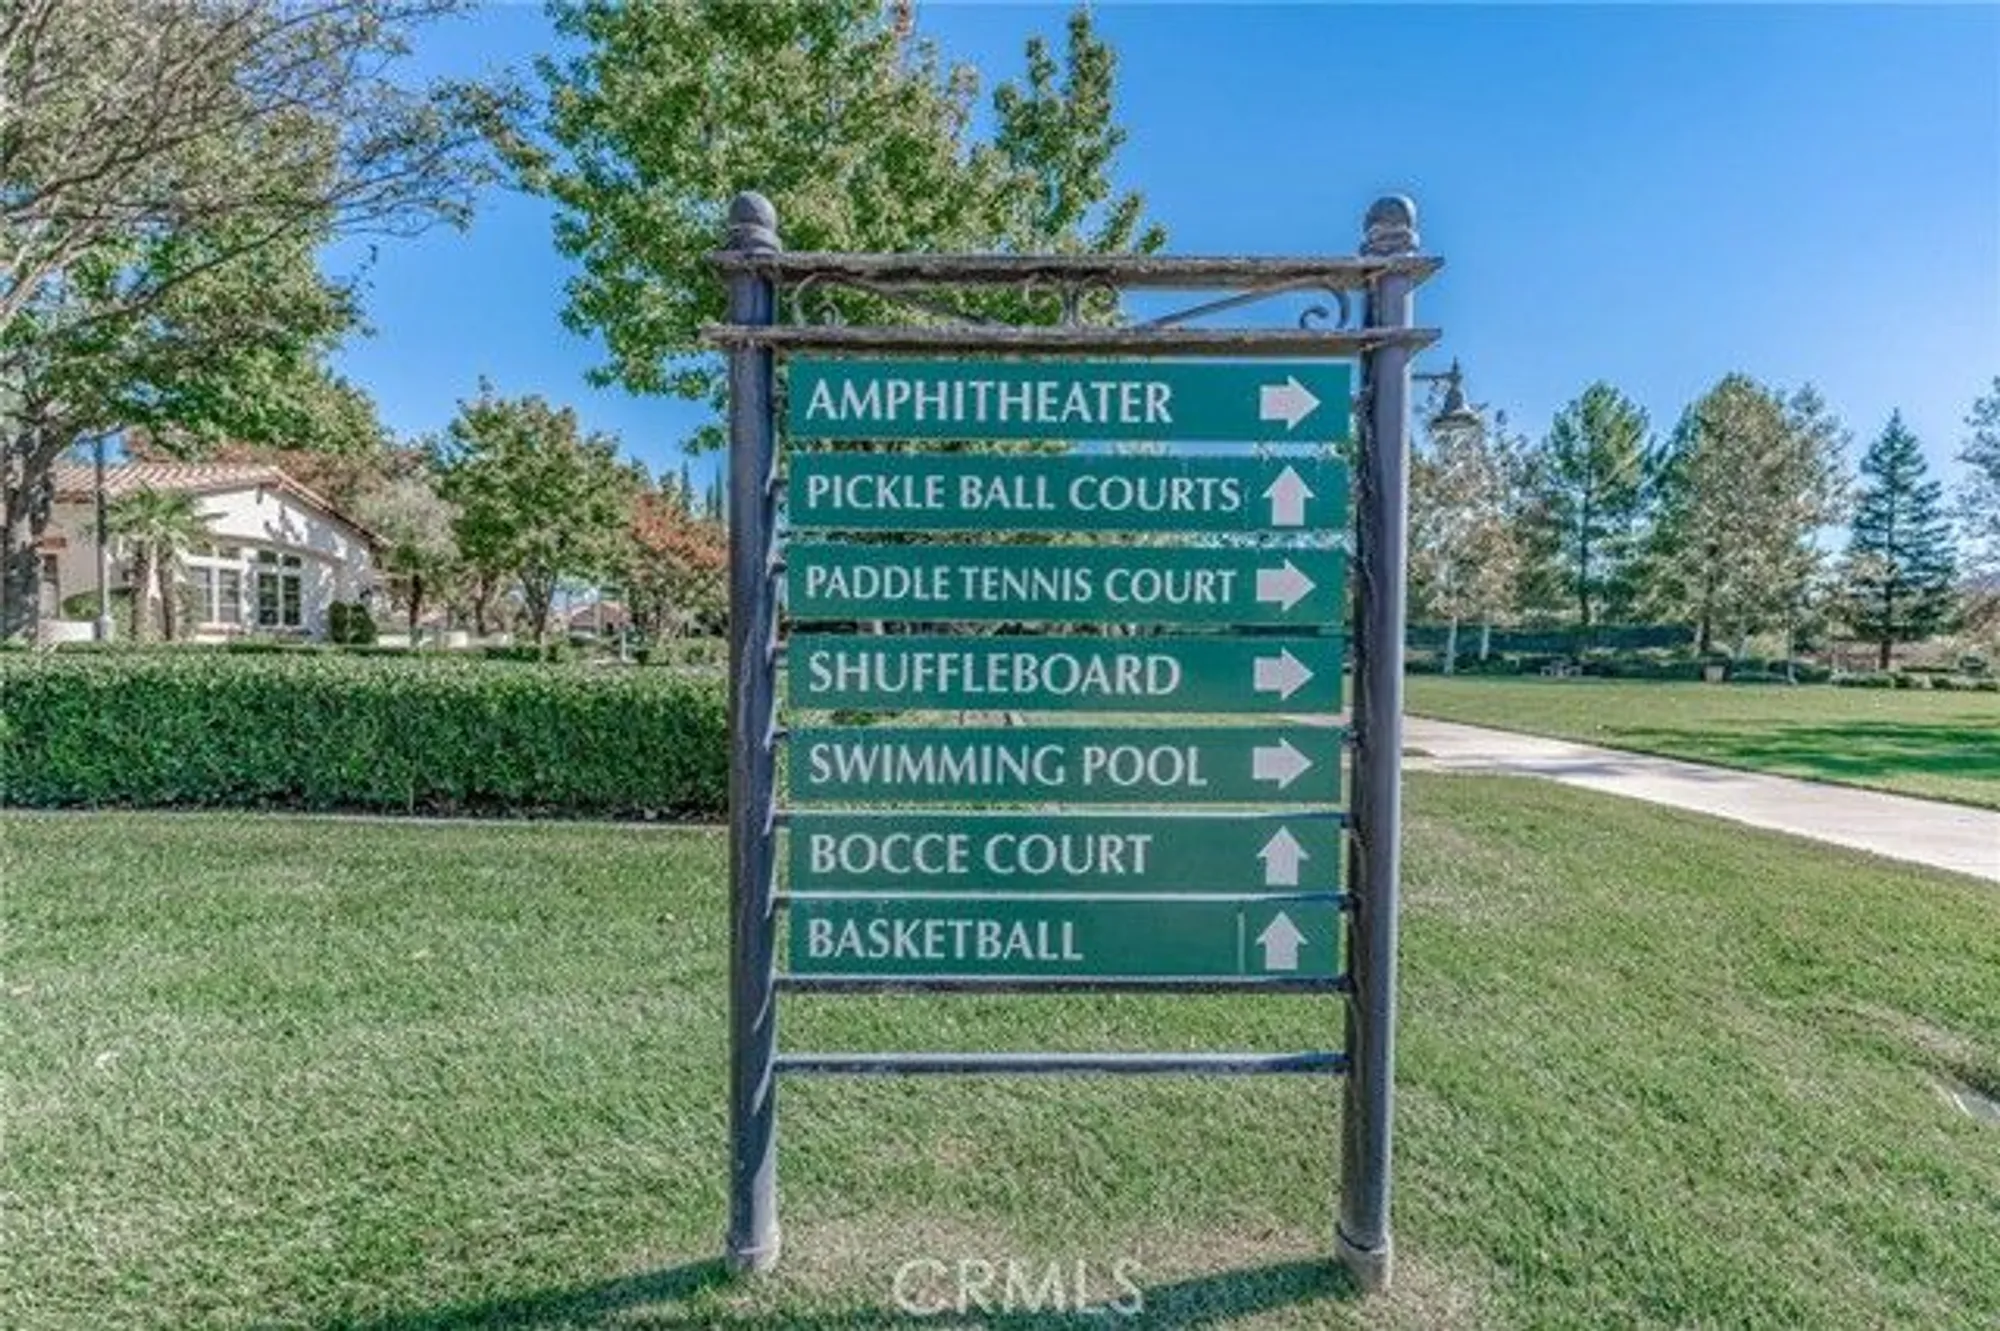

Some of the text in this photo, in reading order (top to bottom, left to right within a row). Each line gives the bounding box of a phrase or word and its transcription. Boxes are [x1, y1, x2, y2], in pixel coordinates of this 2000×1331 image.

[806, 379, 1173, 423] AMPHITHEATER
[807, 474, 1241, 512] PICKLE BALL COURTS
[805, 565, 1238, 604] PADDLE TENNIS COURT
[808, 651, 1181, 696] SHUFFLEBOARD
[809, 743, 1208, 787] SWIMMING POOL
[810, 833, 1153, 875] BOCCE COURT
[808, 918, 1084, 960] BASKETBALL
